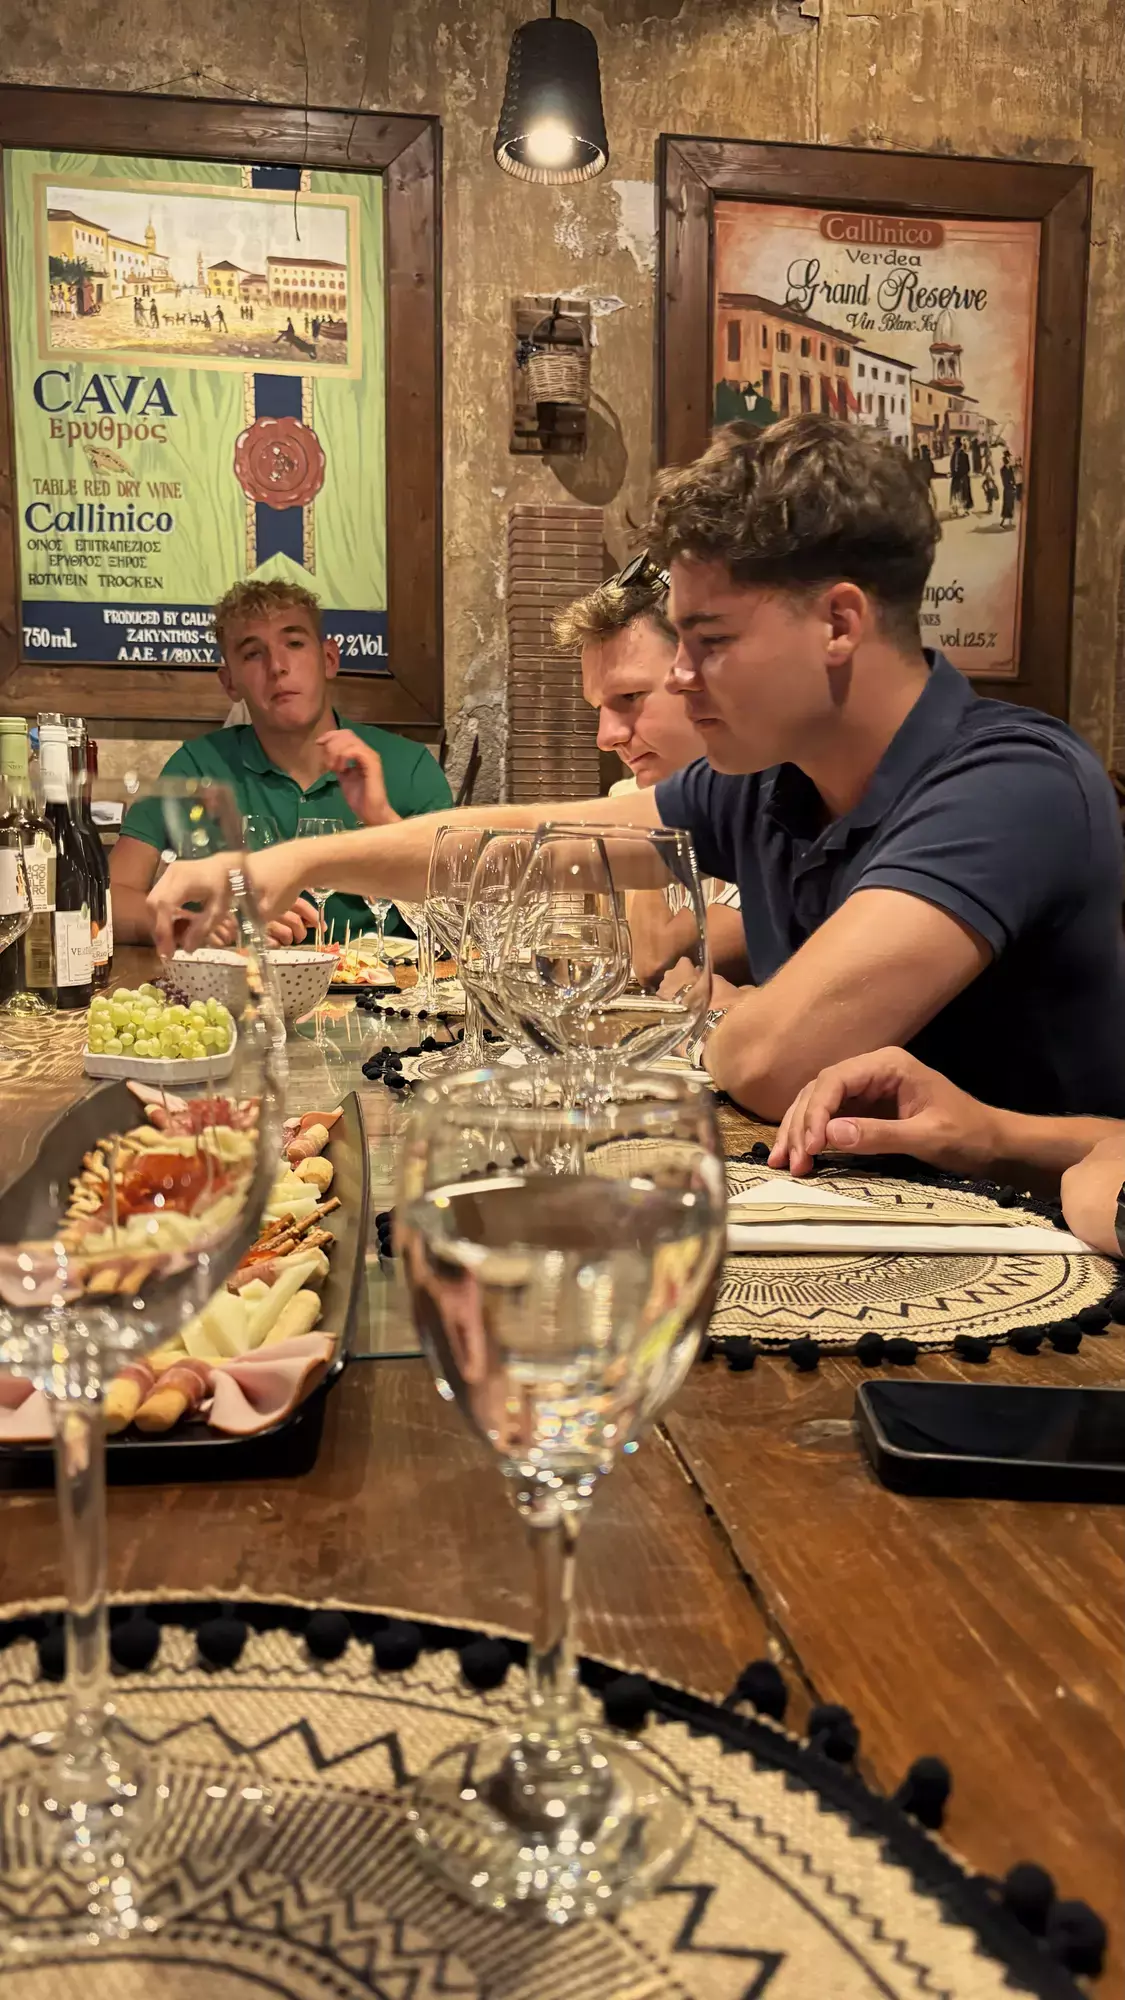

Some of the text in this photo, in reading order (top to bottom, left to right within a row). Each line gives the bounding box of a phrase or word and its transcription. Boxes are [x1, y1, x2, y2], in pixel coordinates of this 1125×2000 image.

[826, 217, 933, 244] Callinico
[846, 249, 922, 267] Verdea
[786, 258, 988, 313] Grand Reserve
[845, 312, 875, 330] Vin
[878, 312, 917, 332] Blanc
[33, 370, 177, 417] CAVA
[49, 416, 168, 449] Ερυθρός
[33, 478, 183, 499] TABLE RED DRY WINE
[24, 501, 174, 534] Callinico
[108, 556, 147, 568] ΞΗΡΟΣ
[28, 573, 164, 589] ROTWEIN TROCKEN
[103, 609, 160, 625] PRODUCED
[164, 612, 179, 625] BY
[23, 627, 78, 649] 750ml.
[117, 646, 158, 661] A.A.E.
